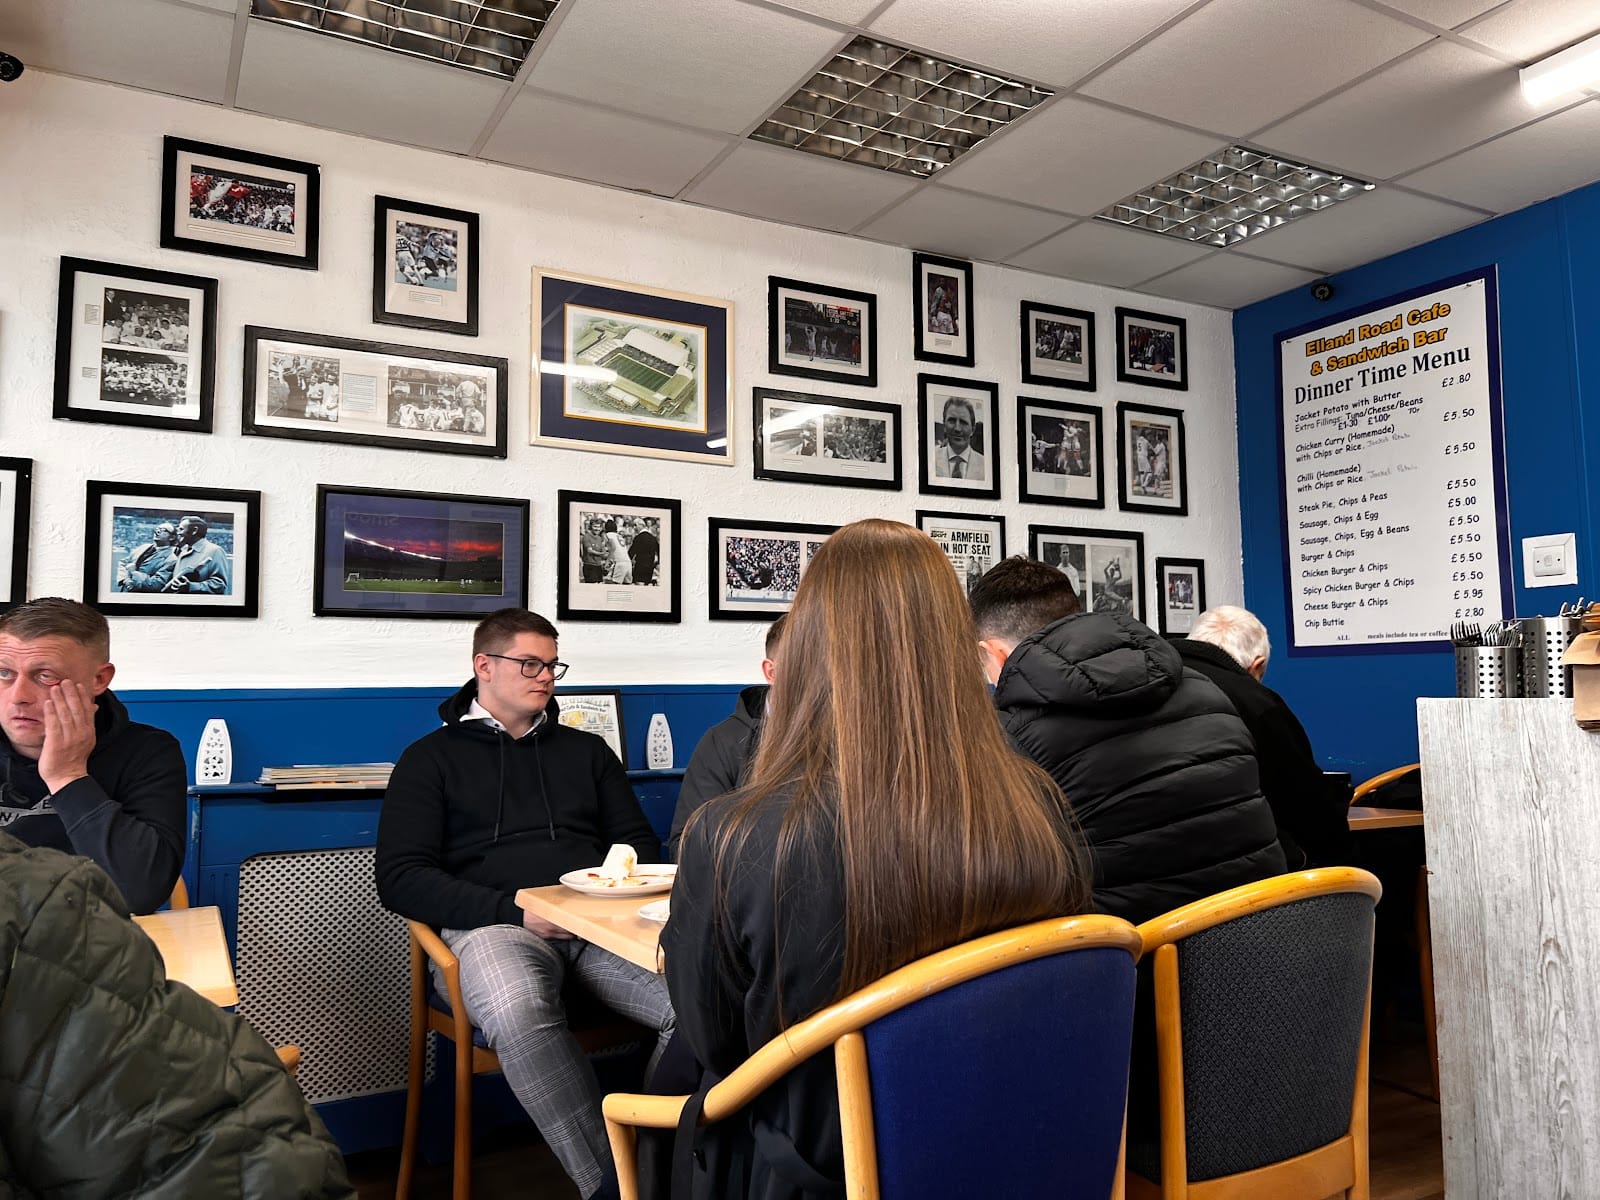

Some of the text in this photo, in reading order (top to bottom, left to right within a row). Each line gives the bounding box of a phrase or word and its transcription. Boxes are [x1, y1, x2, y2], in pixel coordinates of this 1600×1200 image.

[1305, 302, 1451, 357] Elland Road Cafe
[1310, 326, 1449, 377] & Sandwich Bar
[1294, 347, 1472, 405] Dinner Time Menu
[1295, 410, 1321, 422] Jacket
[1323, 404, 1349, 415] Potato
[1351, 396, 1370, 409] with
[1372, 391, 1402, 404] Butter
[1295, 422, 1315, 433] Extra
[1295, 439, 1323, 453] Chicken
[1324, 435, 1345, 447] Curry
[1347, 423, 1395, 443] (Homemade)
[1296, 451, 1311, 462] with
[1313, 448, 1333, 459] Chips
[1335, 447, 1343, 455] or
[1296, 471, 1314, 483] Chilli
[1316, 463, 1362, 481] (Homemade)
[1297, 483, 1312, 493] with
[1314, 480, 1334, 490] Chips
[1336, 478, 1344, 486] or
[1298, 501, 1320, 512] Steak
[1338, 497, 1359, 507] Chips
[1361, 494, 1367, 503] &
[1369, 492, 1388, 501] Peas
[1333, 515, 1353, 525] Chips
[1356, 512, 1362, 521] &
[1364, 511, 1379, 521] Egg
[950, 531, 990, 544] ARMFIELD
[1360, 528, 1375, 539] Egg
[1377, 527, 1383, 536] &
[1386, 524, 1410, 534] Beans
[952, 543, 969, 554] HOT
[971, 544, 991, 556] SEAT
[1300, 553, 1325, 563] Burger
[1327, 550, 1333, 559] &
[1335, 549, 1355, 559] Chips
[1301, 569, 1329, 578] Chicken
[1331, 566, 1356, 576] Burger
[1358, 564, 1365, 572] &
[1367, 562, 1389, 572] Chips
[1303, 586, 1322, 596] Spicy
[1324, 583, 1353, 593] Chicken
[1355, 581, 1381, 591] Burger
[1384, 579, 1390, 588] &
[1392, 577, 1415, 588] Chips
[1303, 602, 1329, 611] Cheese
[1331, 600, 1356, 611] Burger
[1358, 598, 1365, 607] &
[1367, 597, 1389, 608] Chips
[1304, 619, 1320, 629] Chip
[1322, 617, 1345, 627] Buttie
[1386, 631, 1407, 639] include
